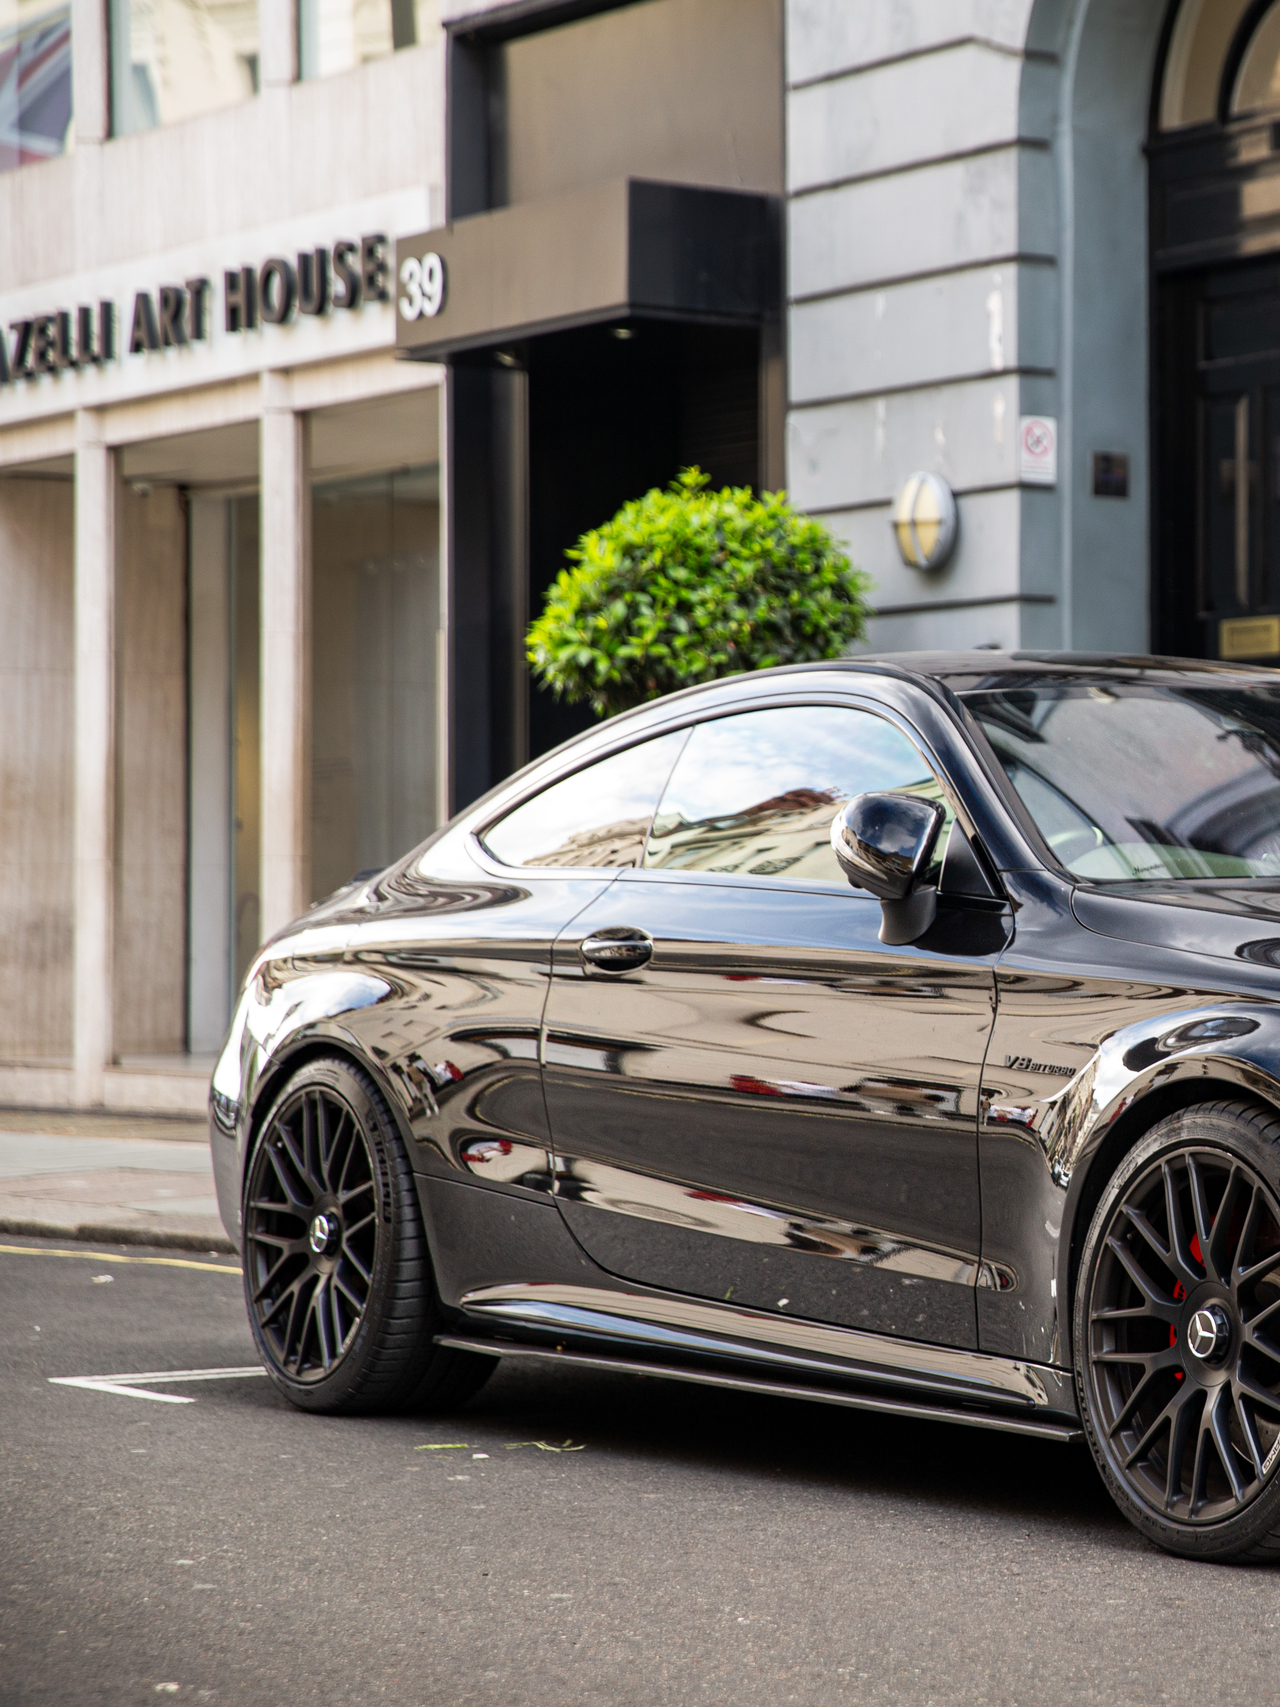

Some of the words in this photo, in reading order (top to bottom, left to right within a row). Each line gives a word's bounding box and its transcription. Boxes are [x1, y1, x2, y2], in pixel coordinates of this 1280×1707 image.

[130, 278, 209, 353] ART
[224, 234, 390, 333] HOUSE
[400, 252, 444, 321] 39
[1005, 1055, 1032, 1070] V8
[1030, 1064, 1076, 1077] BITURBO
